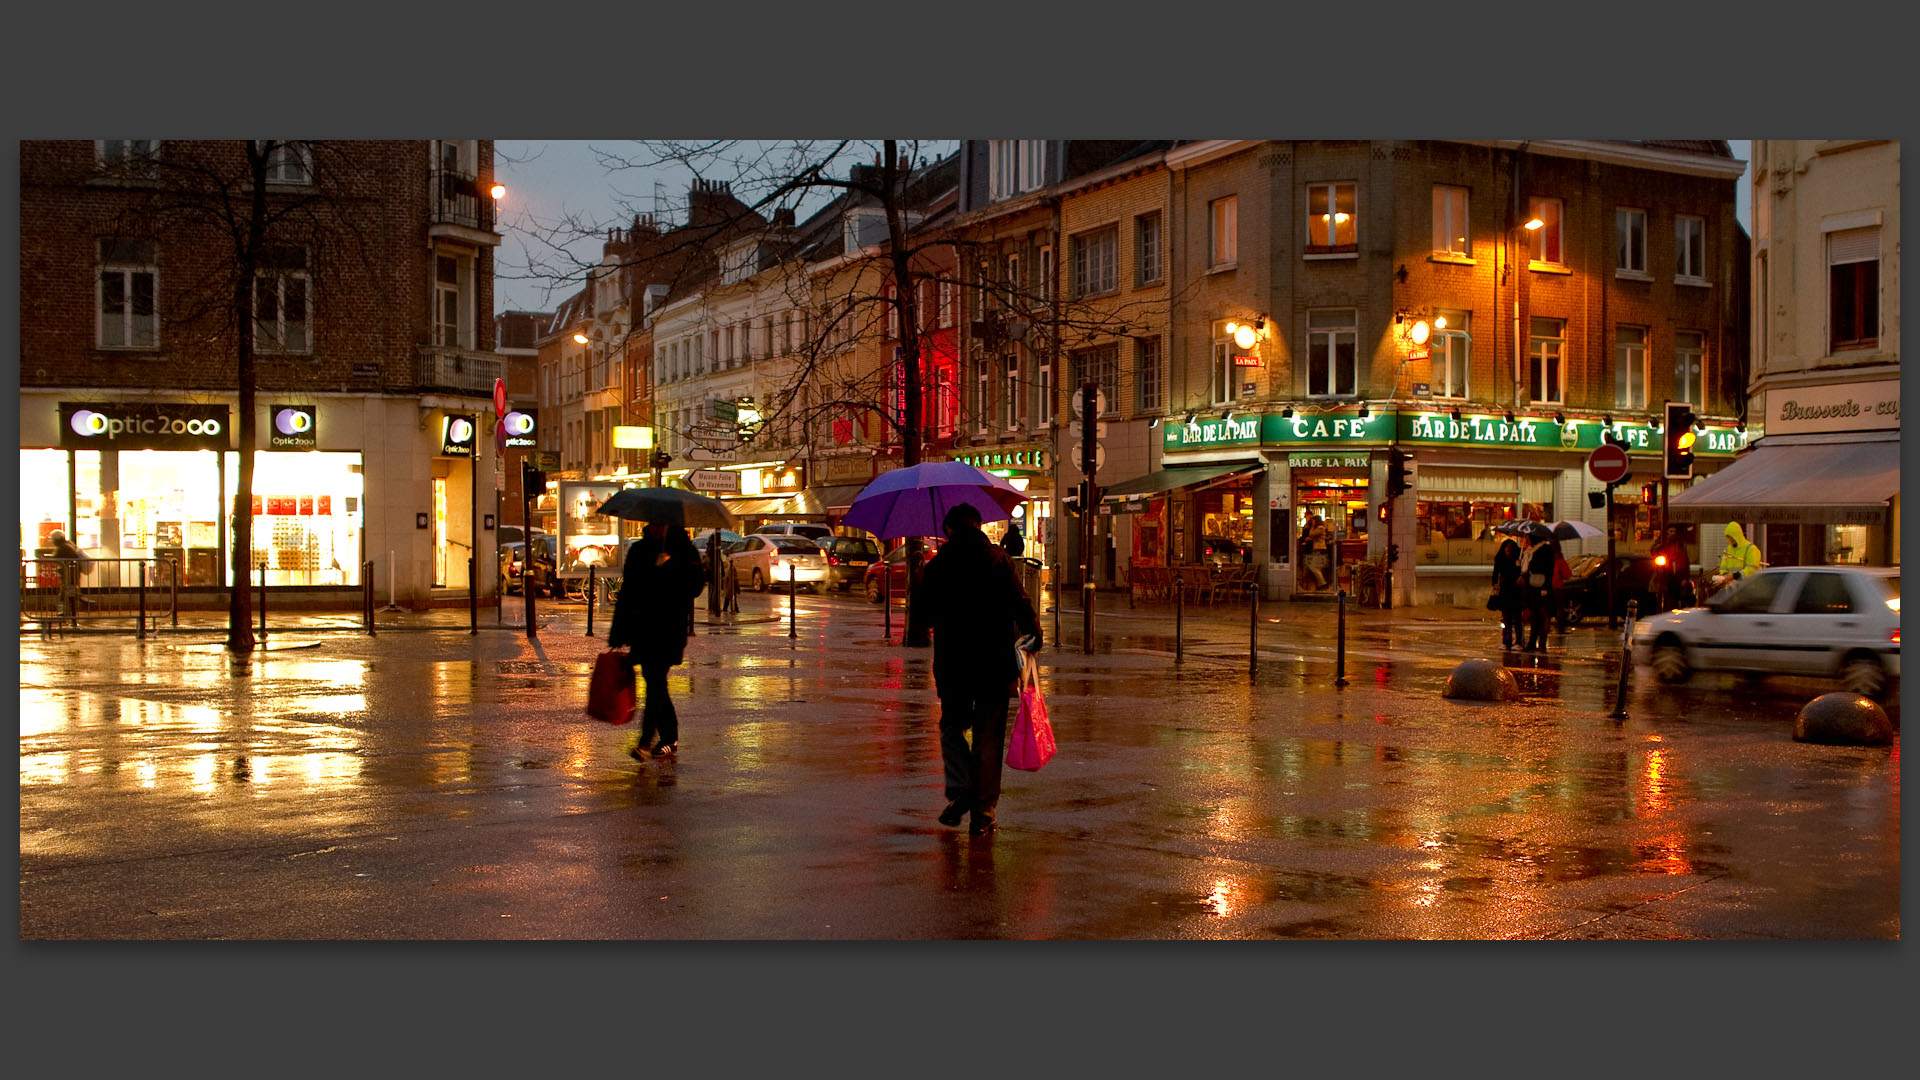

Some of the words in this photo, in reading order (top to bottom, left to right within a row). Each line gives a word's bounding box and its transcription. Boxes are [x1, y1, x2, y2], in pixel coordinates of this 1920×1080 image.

[1781, 399, 1861, 421] Brasserie
[1182, 425, 1202, 443] BAR
[1203, 423, 1217, 442] DE
[1218, 423, 1231, 441] LA
[1232, 420, 1257, 440] PAIX
[1292, 418, 1366, 438] CAFE
[1412, 420, 1445, 438] BAR
[1449, 421, 1471, 440] DE
[1474, 422, 1495, 441] LA
[1499, 423, 1537, 443] PAIX
[1708, 432, 1736, 450] BAR
[1289, 458, 1309, 468] BAR
[1310, 458, 1323, 467] DE
[1326, 458, 1340, 467] LA
[1344, 457, 1368, 468] PAIX
